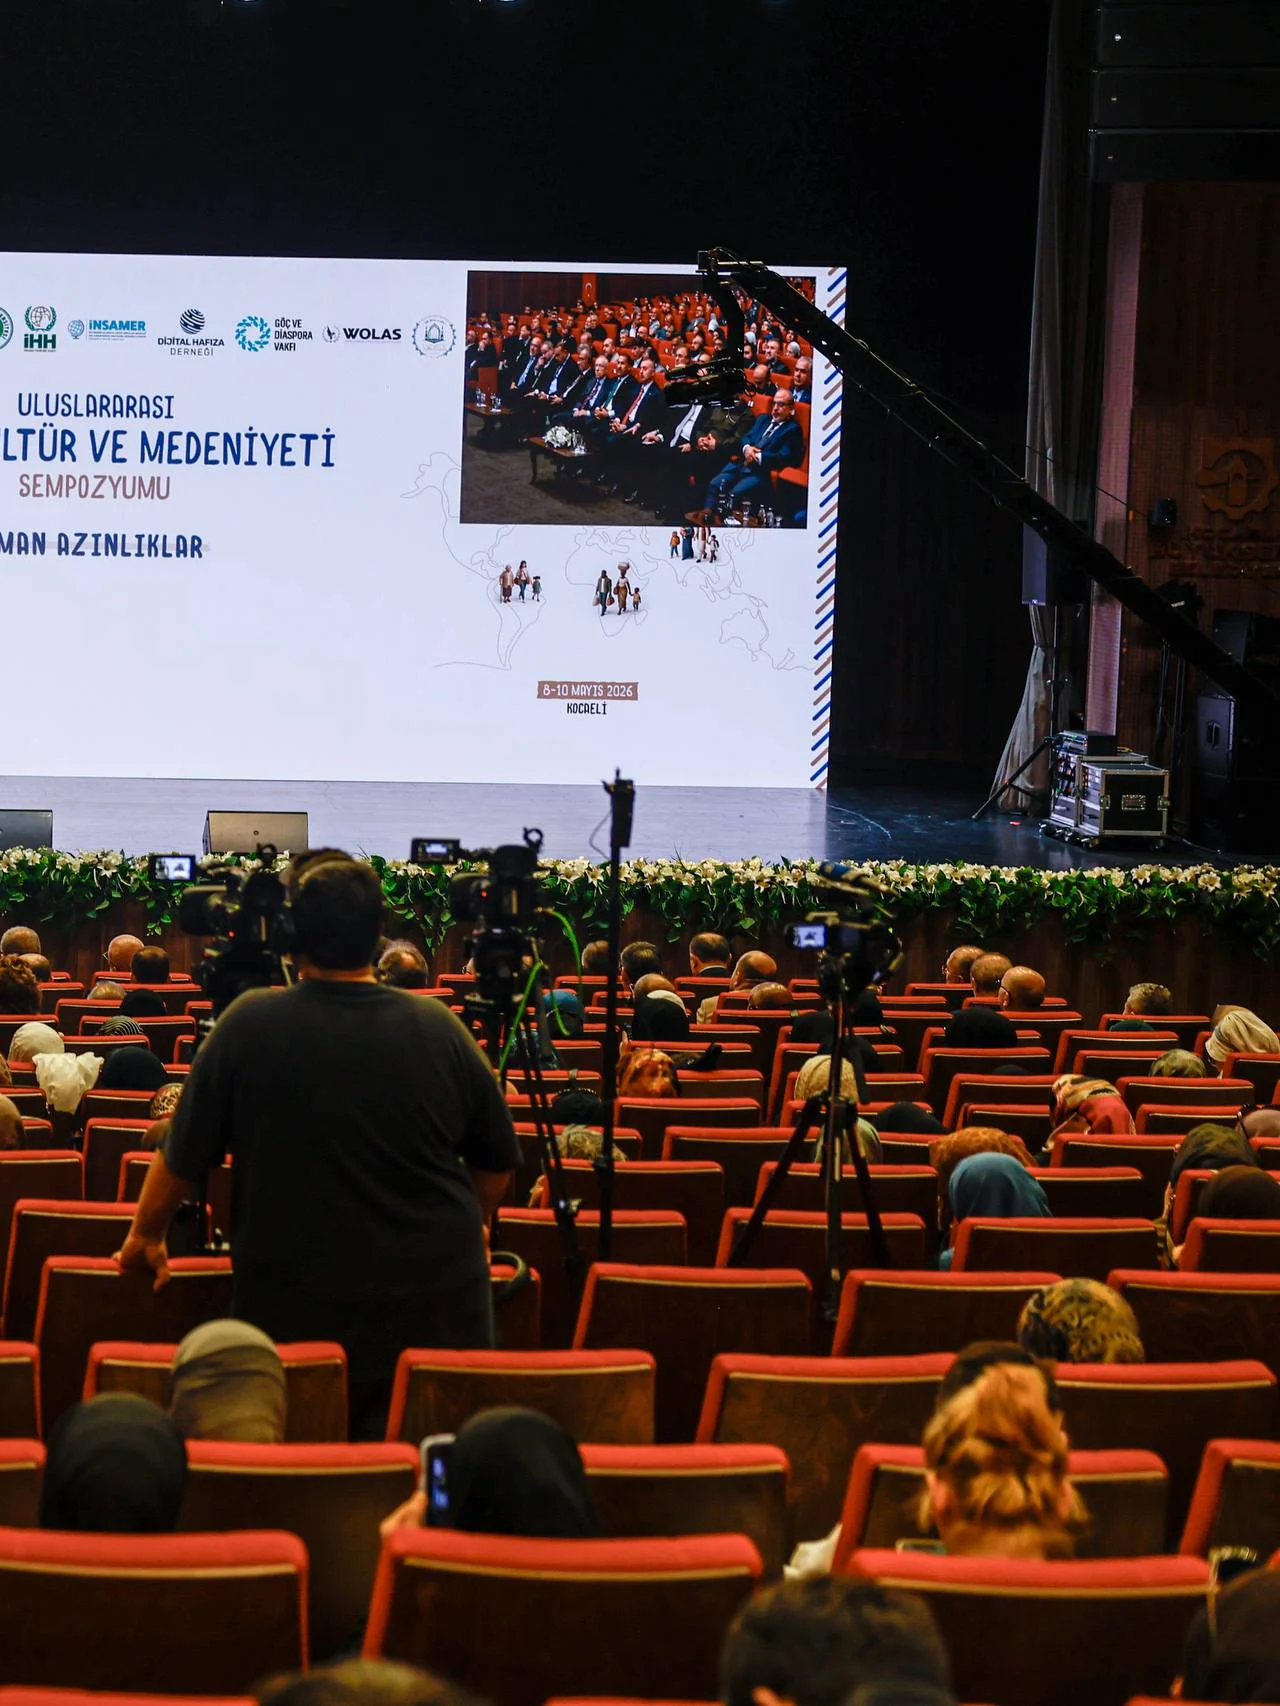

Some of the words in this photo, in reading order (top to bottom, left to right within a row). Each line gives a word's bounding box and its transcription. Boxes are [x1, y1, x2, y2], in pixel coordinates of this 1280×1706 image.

[275, 317, 291, 329] GÖÇ
[292, 319, 302, 328] VE
[274, 328, 313, 340] DİASPORA
[343, 327, 402, 340] WOLAS
[192, 338, 225, 346] HAFIZA
[274, 342, 296, 351] VAKFI
[170, 347, 214, 356] DERNEĞİ
[17, 392, 175, 420] ULUSLARARASI
[89, 429, 128, 464] VE
[139, 425, 336, 468] MEDENİYETİ
[19, 473, 171, 501] SEMPOZYUMU
[57, 532, 203, 559] AZINLIKLAR
[543, 684, 569, 696] 8-10
[571, 684, 604, 697] MAYIS
[606, 685, 633, 697] 2026
[566, 701, 607, 715] KOCAELİ
